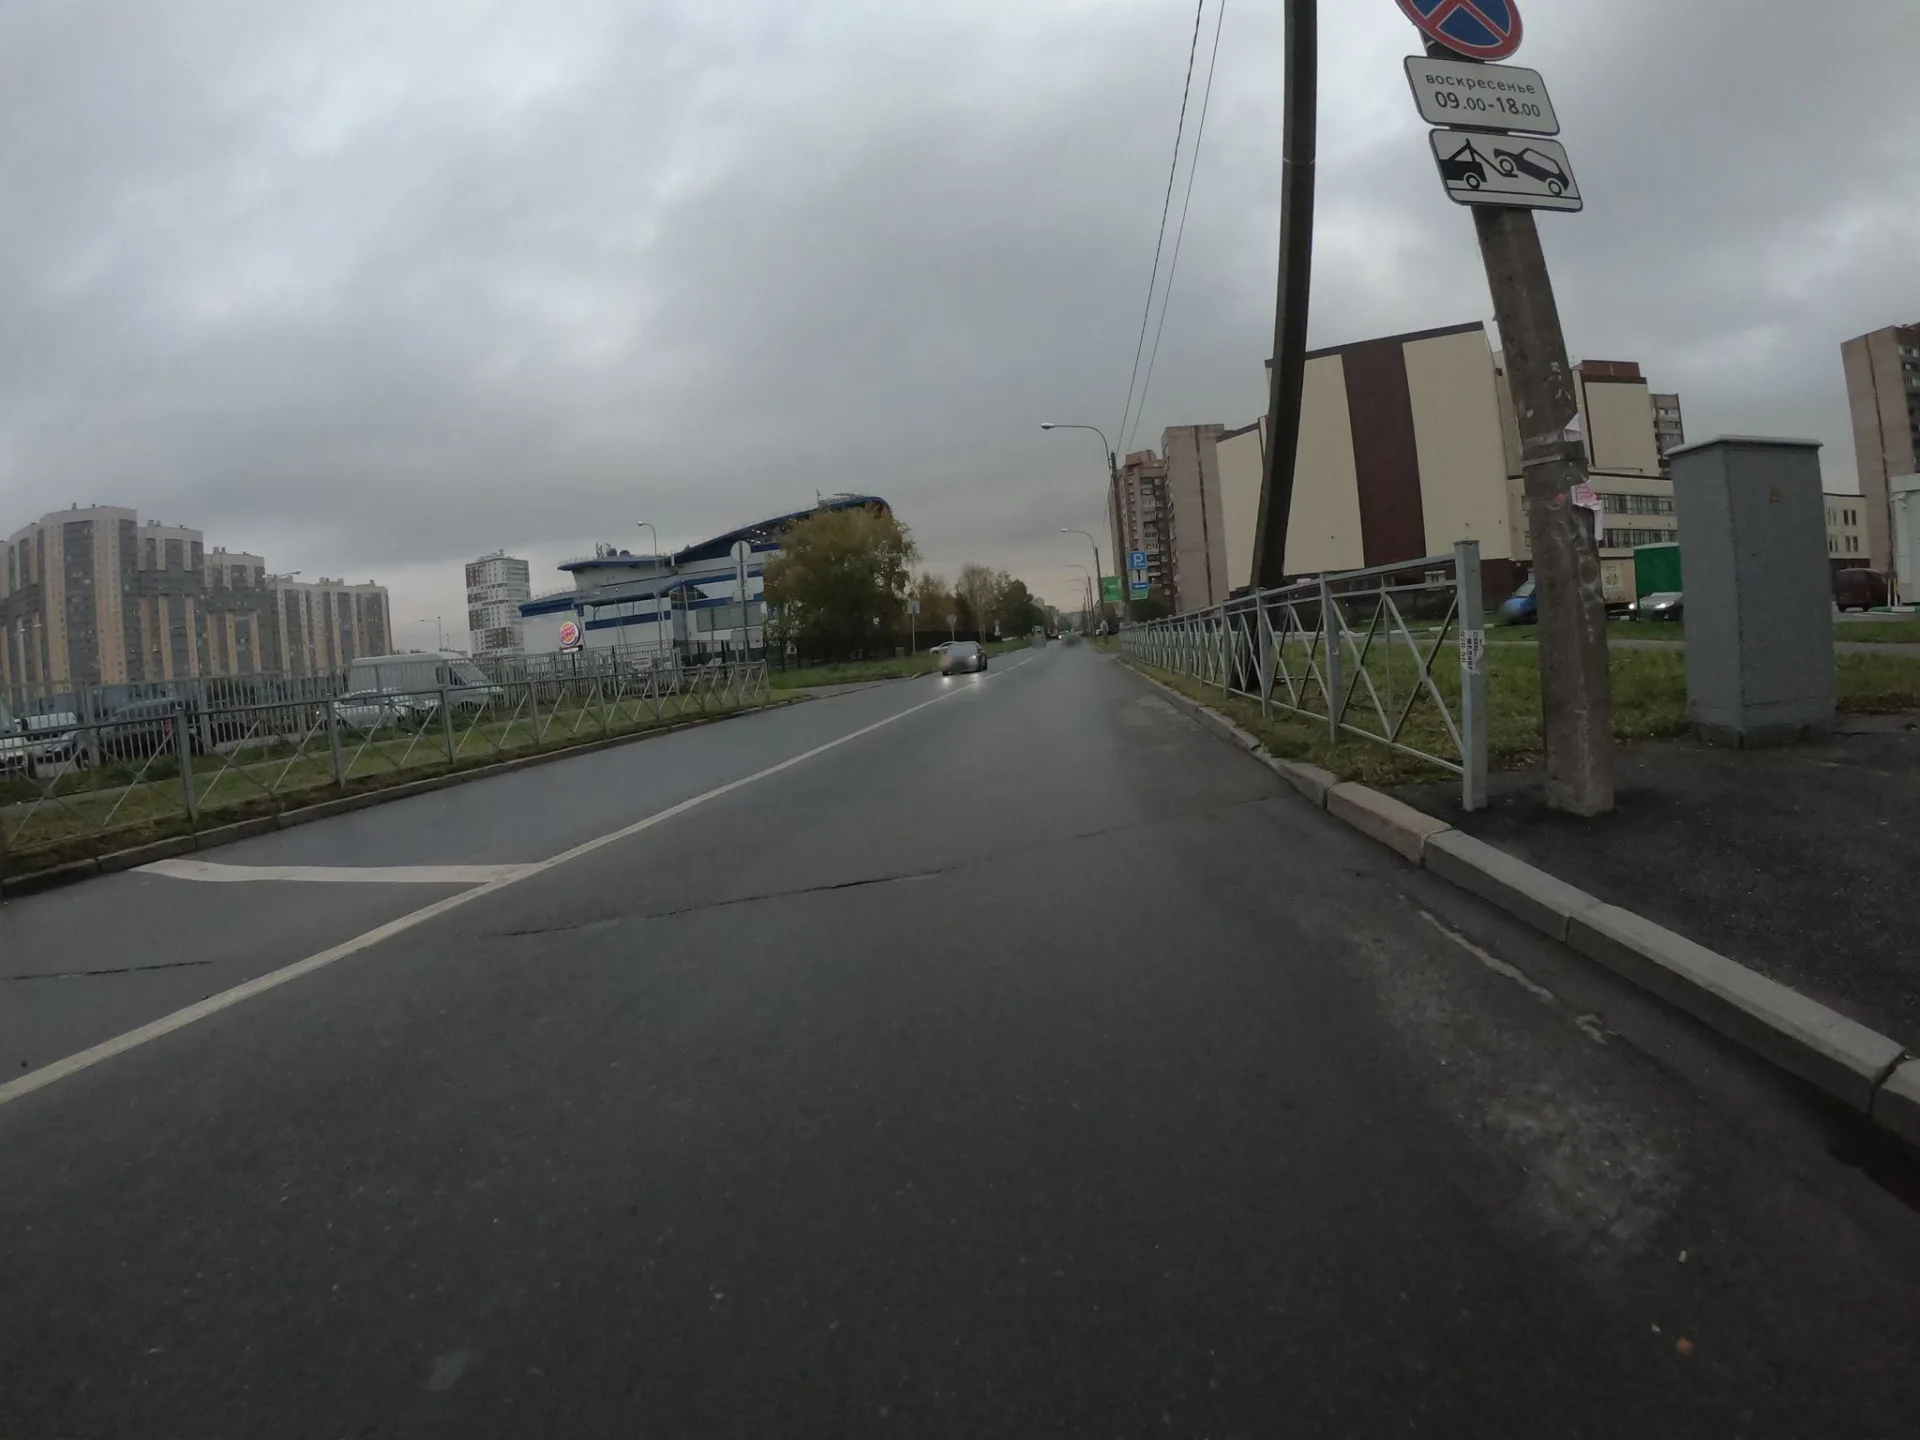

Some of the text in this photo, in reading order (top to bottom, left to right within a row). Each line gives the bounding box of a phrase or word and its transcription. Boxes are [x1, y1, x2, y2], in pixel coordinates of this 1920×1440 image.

[1425, 74, 1536, 94] воскресенье
[1434, 91, 1541, 117] 09.00-18.00
[1133, 553, 1144, 567] P
